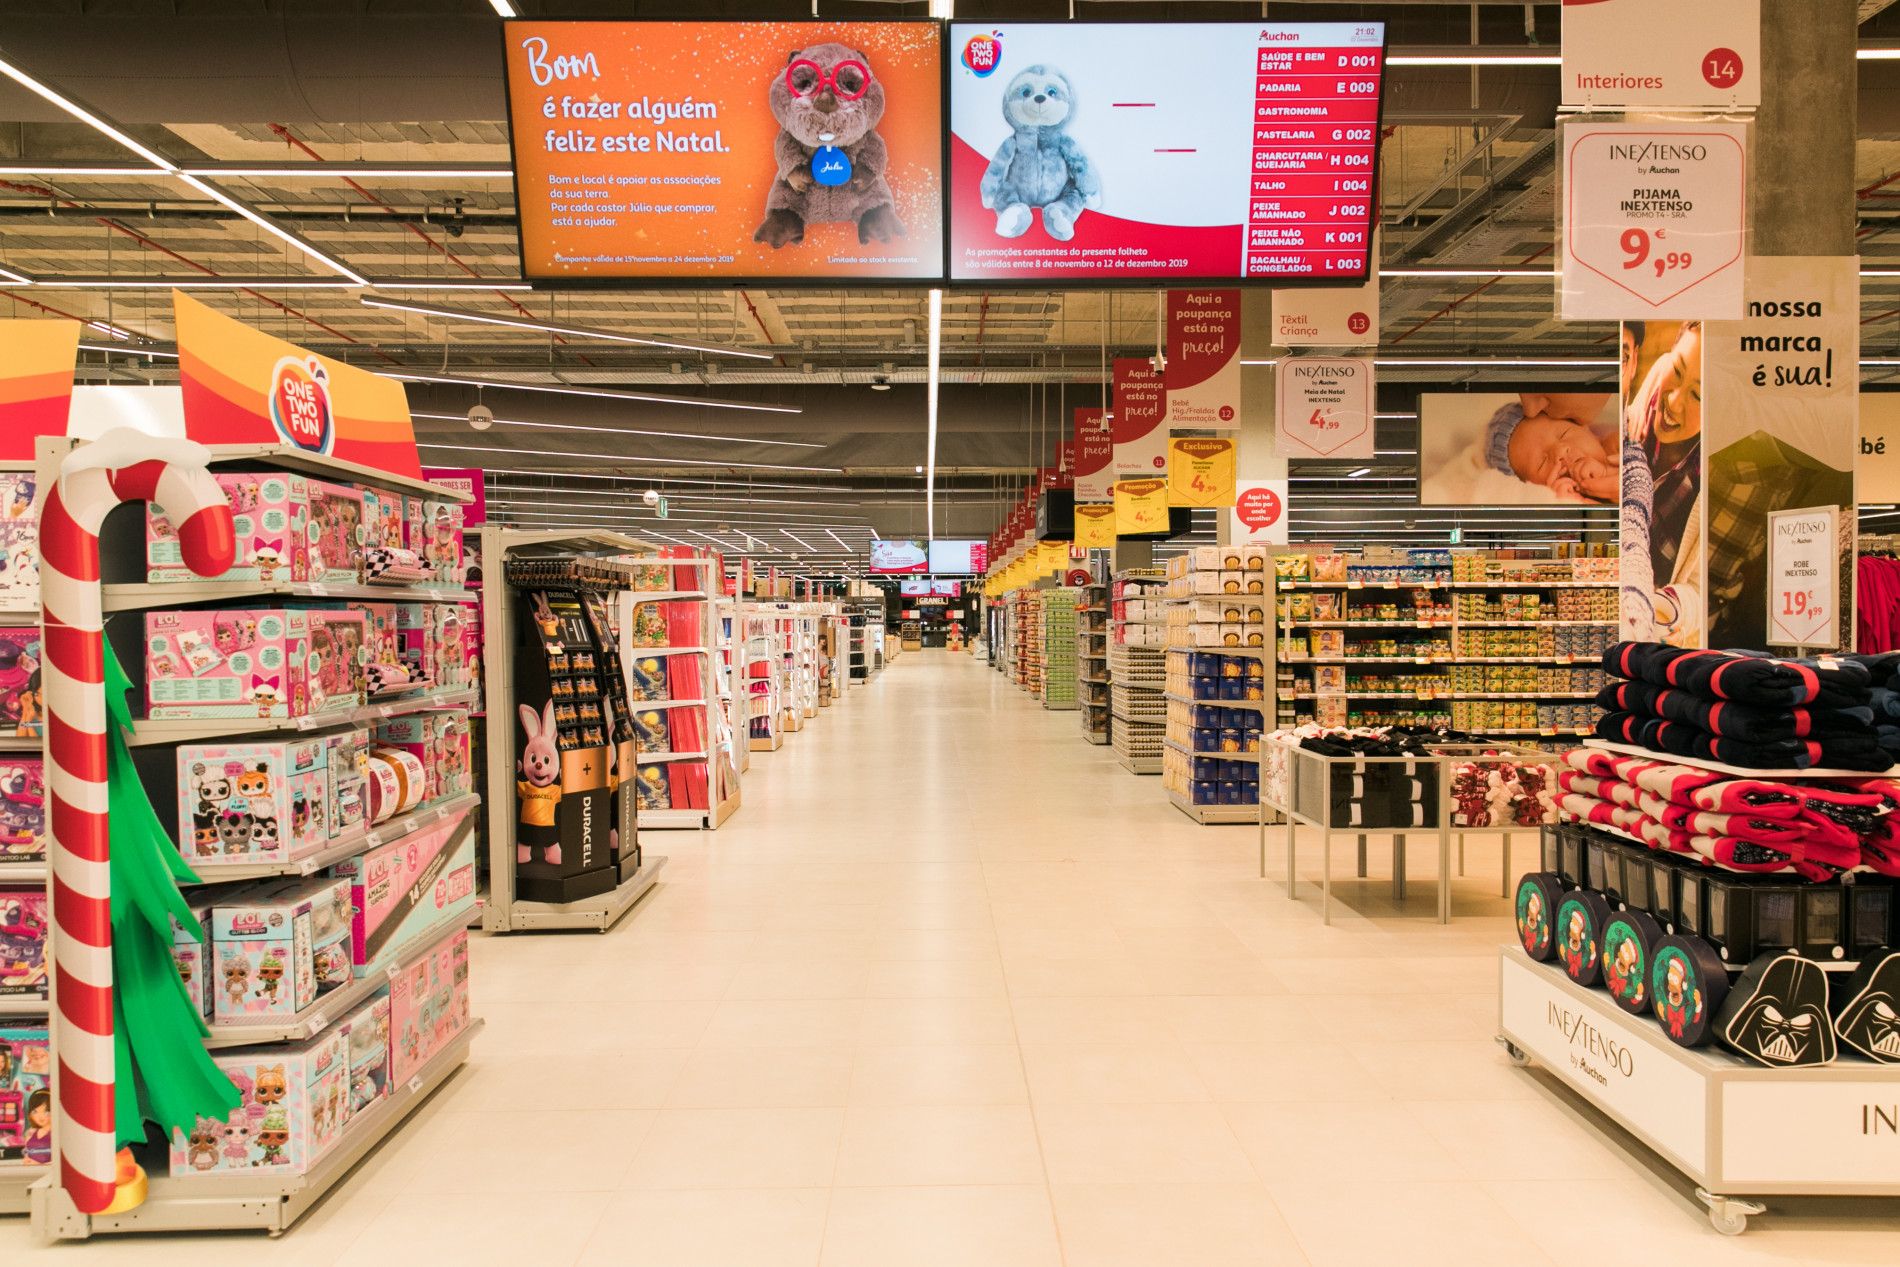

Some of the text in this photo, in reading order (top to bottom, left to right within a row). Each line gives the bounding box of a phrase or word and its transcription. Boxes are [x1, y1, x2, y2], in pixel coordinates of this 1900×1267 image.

[1258, 29, 1300, 41] Auchan
[1355, 28, 1376, 36] 21:02
[970, 41, 993, 50] ONE
[971, 49, 993, 58] TWO
[1261, 51, 1325, 61] SAÚDE E BEM
[521, 36, 601, 87] Bom
[973, 57, 993, 66] FUN
[1260, 62, 1292, 70] ESTAR
[1337, 55, 1376, 67] D 001
[1709, 61, 1735, 79] 14
[1577, 73, 1663, 89] Interiores
[1259, 82, 1375, 93] PADARIA E 009
[543, 95, 717, 125] é fazer alguém
[1258, 107, 1328, 116] GASTRONOMIA
[1257, 129, 1371, 140] PASTELARIA G 002
[545, 129, 731, 152] feliz este Natal.
[1256, 152, 1323, 160] CHARCUTARIA
[1609, 141, 1706, 163] INEXTENSO
[1255, 161, 1306, 169] QUEIJARIA
[1330, 155, 1369, 166] H 004
[1637, 165, 1680, 175] by Auchan
[548, 174, 721, 187] Bom e local é apoiar as associações
[1254, 180, 1367, 191] TALHO I 004
[550, 189, 562, 199] da
[565, 190, 582, 199] sua
[1633, 189, 1681, 201] PIJAMA
[551, 203, 567, 213] Por
[570, 203, 593, 213] cada
[596, 204, 626, 213] castor
[630, 202, 652, 213] Júlio
[654, 204, 672, 215] que
[1253, 202, 1280, 211] PEIXE
[1328, 205, 1366, 216] J 002
[1620, 200, 1693, 212] INEXTENSO
[1252, 211, 1306, 219] AMANHADO
[552, 216, 573, 226] está
[1251, 228, 1301, 238] PEIXE NÃO
[1325, 232, 1362, 243] K 001
[1251, 238, 1304, 246] AMANHADO
[965, 247, 1148, 258] As promoções constantes do presente folheto
[1013, 260, 1034, 268] entre
[1042, 259, 1052, 267] de
[1054, 259, 1095, 267] novembro
[1103, 259, 1113, 267] 12
[1115, 259, 1125, 267] de
[1126, 259, 1167, 267] dezembro
[1168, 259, 1188, 267] 2019
[1250, 256, 1300, 264] BACALHAU
[1325, 259, 1361, 269] L 003
[1249, 265, 1312, 273] CONGELADOS
[1186, 294, 1222, 306] Aqui a
[1747, 301, 1821, 317] nossa
[1176, 310, 1232, 321] poupança
[1280, 315, 1307, 324] Têxtil
[1183, 324, 1208, 333] está
[1352, 319, 1365, 329] 13
[1280, 326, 1318, 337] Criança
[1182, 335, 1224, 361] preço!
[1740, 336, 1821, 352] marca
[1295, 365, 1355, 379] INEXTENSO
[1752, 348, 1832, 388] é sua!
[1128, 370, 1148, 379] Aqui
[283, 377, 315, 402] ONE
[1120, 382, 1164, 391] poupança
[1126, 391, 1145, 400] está
[285, 395, 318, 418] TWO
[1172, 399, 1190, 407] Bebé
[1125, 401, 1158, 421] preço!
[1221, 410, 1232, 418] 12
[1172, 414, 1217, 423] Alimentação
[290, 413, 320, 437] FUN
[460, 481, 471, 490] SER
[1778, 520, 1826, 537] INEXTENSO
[1793, 560, 1809, 568] ROBE
[1784, 569, 1818, 577] INEXTENSO
[547, 591, 575, 599] DURACELL
[582, 796, 592, 868] DURACELL
[1549, 1000, 1633, 1077] INEXTENSO
[1579, 1057, 1608, 1086] Auchan
